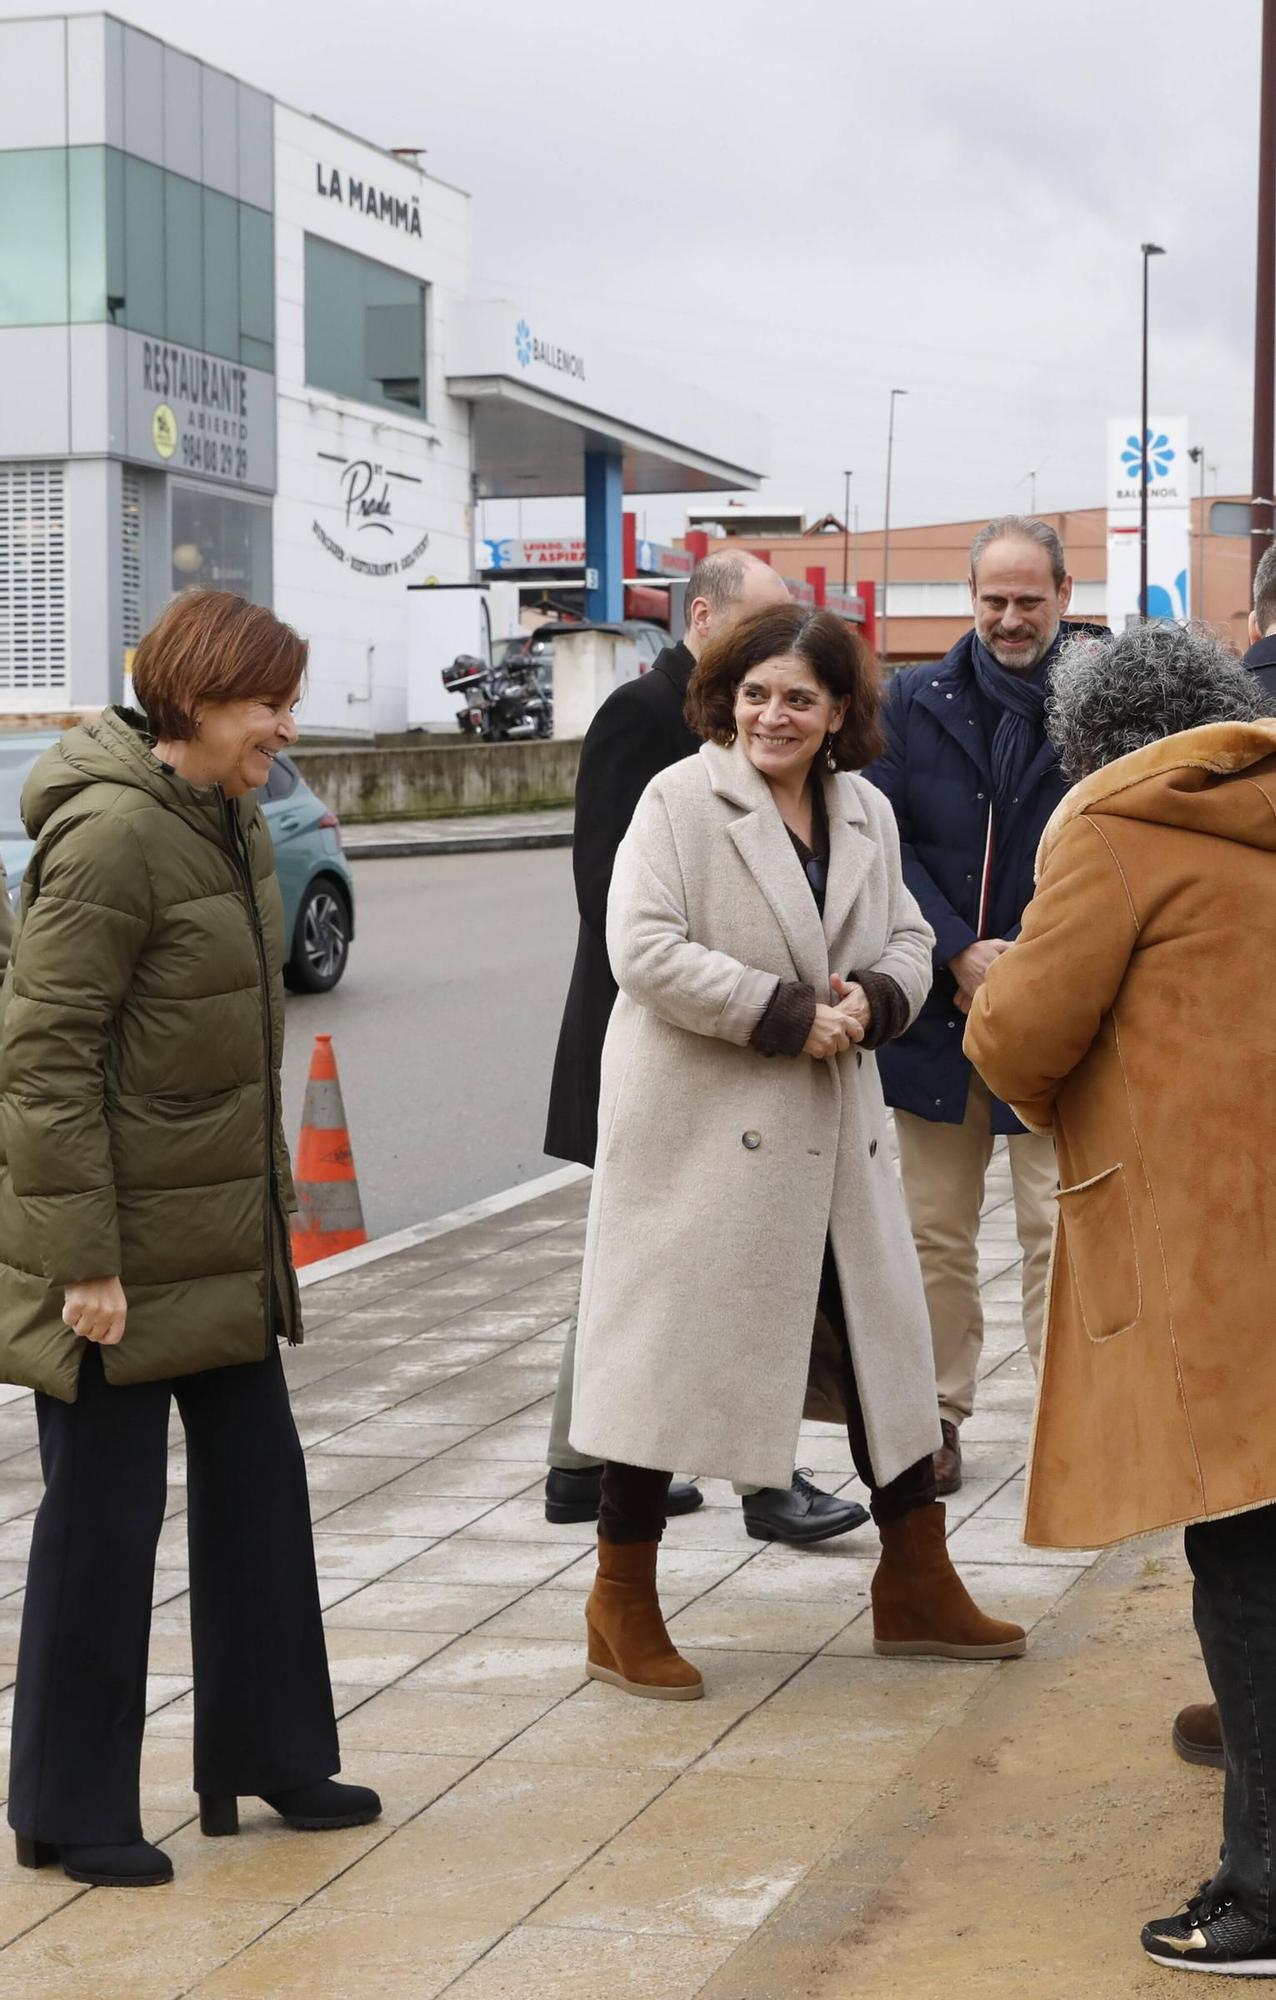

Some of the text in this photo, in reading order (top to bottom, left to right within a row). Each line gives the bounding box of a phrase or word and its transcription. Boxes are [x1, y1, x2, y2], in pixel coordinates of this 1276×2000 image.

[317, 163, 343, 203] LA
[143, 342, 247, 417] RESTAURANTE
[533, 338, 586, 381] BALLENOIL
[187, 411, 248, 440] ABIERTO
[183, 434, 202, 466] 984
[220, 445, 232, 474] 29
[236, 448, 248, 478] 29
[1116, 488, 1178, 499] BALLNOIL
[525, 553, 532, 563] Y
